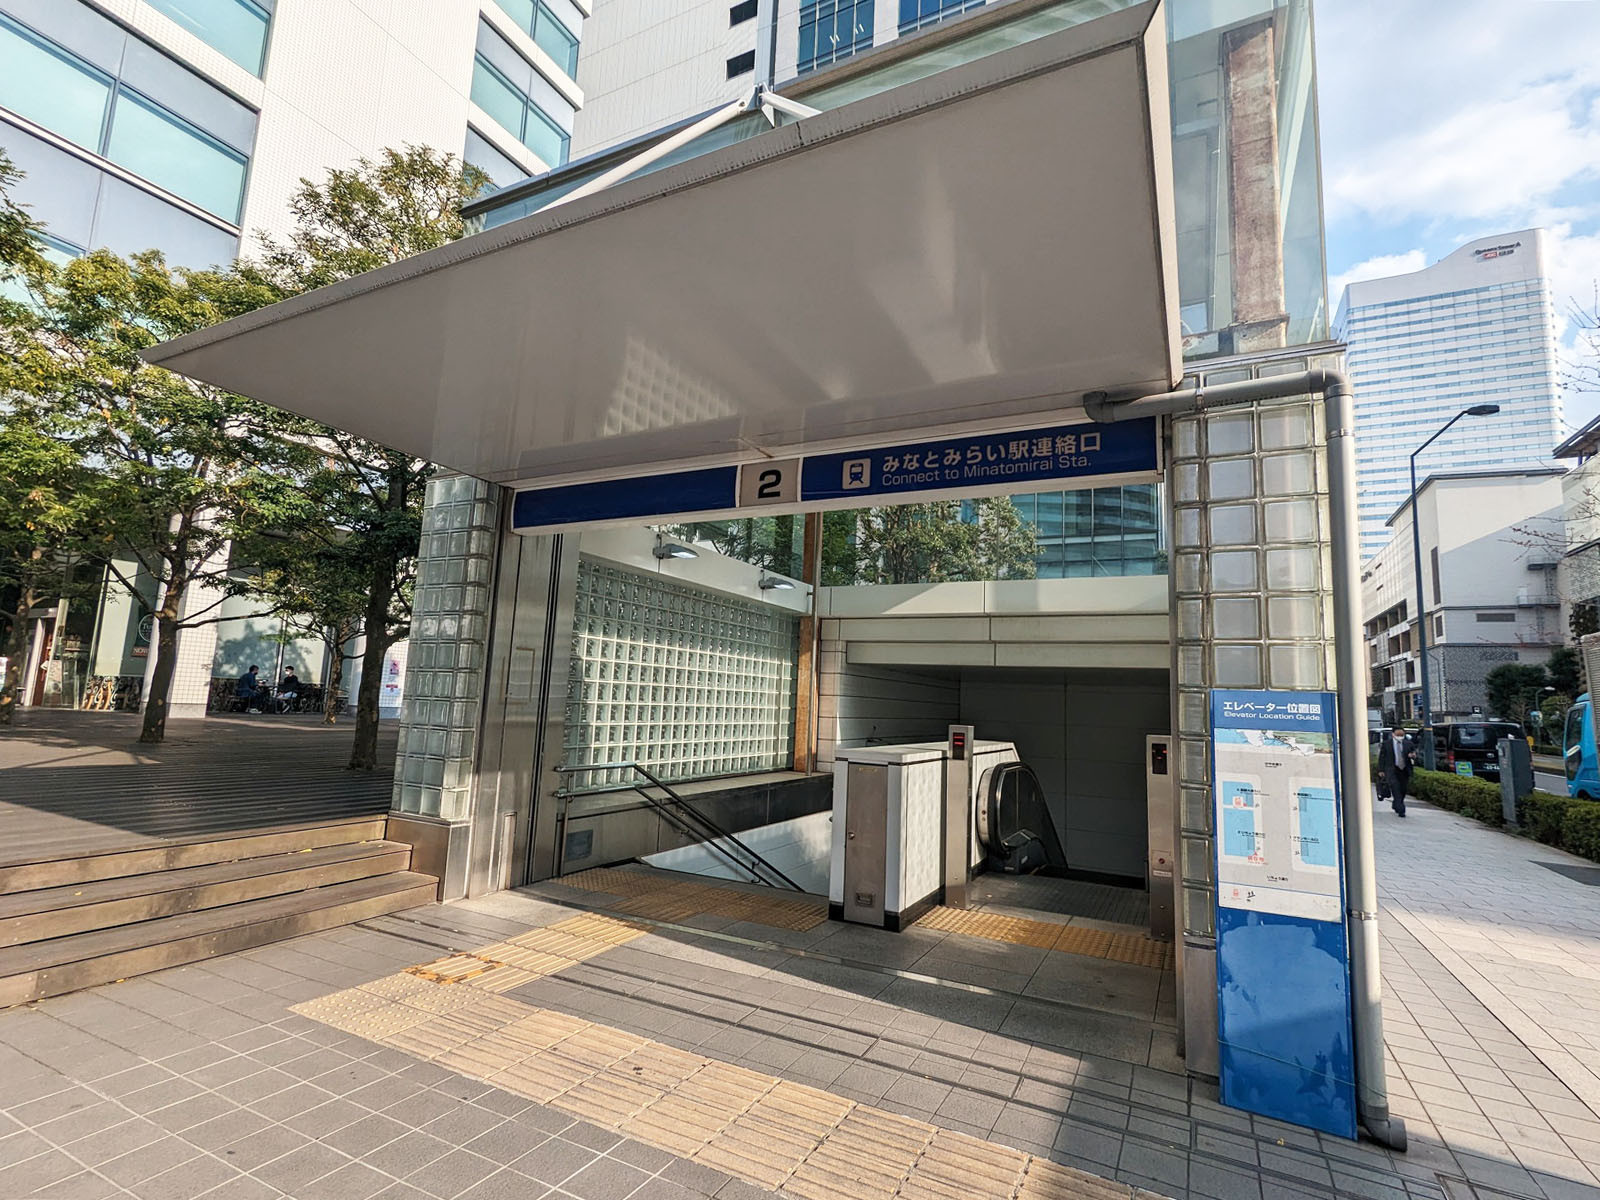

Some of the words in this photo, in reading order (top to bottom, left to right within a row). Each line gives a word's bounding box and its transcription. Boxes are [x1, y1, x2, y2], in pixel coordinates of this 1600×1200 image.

[882, 432, 1101, 472] みなとみらい駅連絡口
[758, 469, 782, 499] 2
[882, 469, 940, 486] Connect
[944, 467, 959, 480] to
[963, 457, 1053, 478] Minatomirai
[1058, 456, 1092, 468] Sta.
